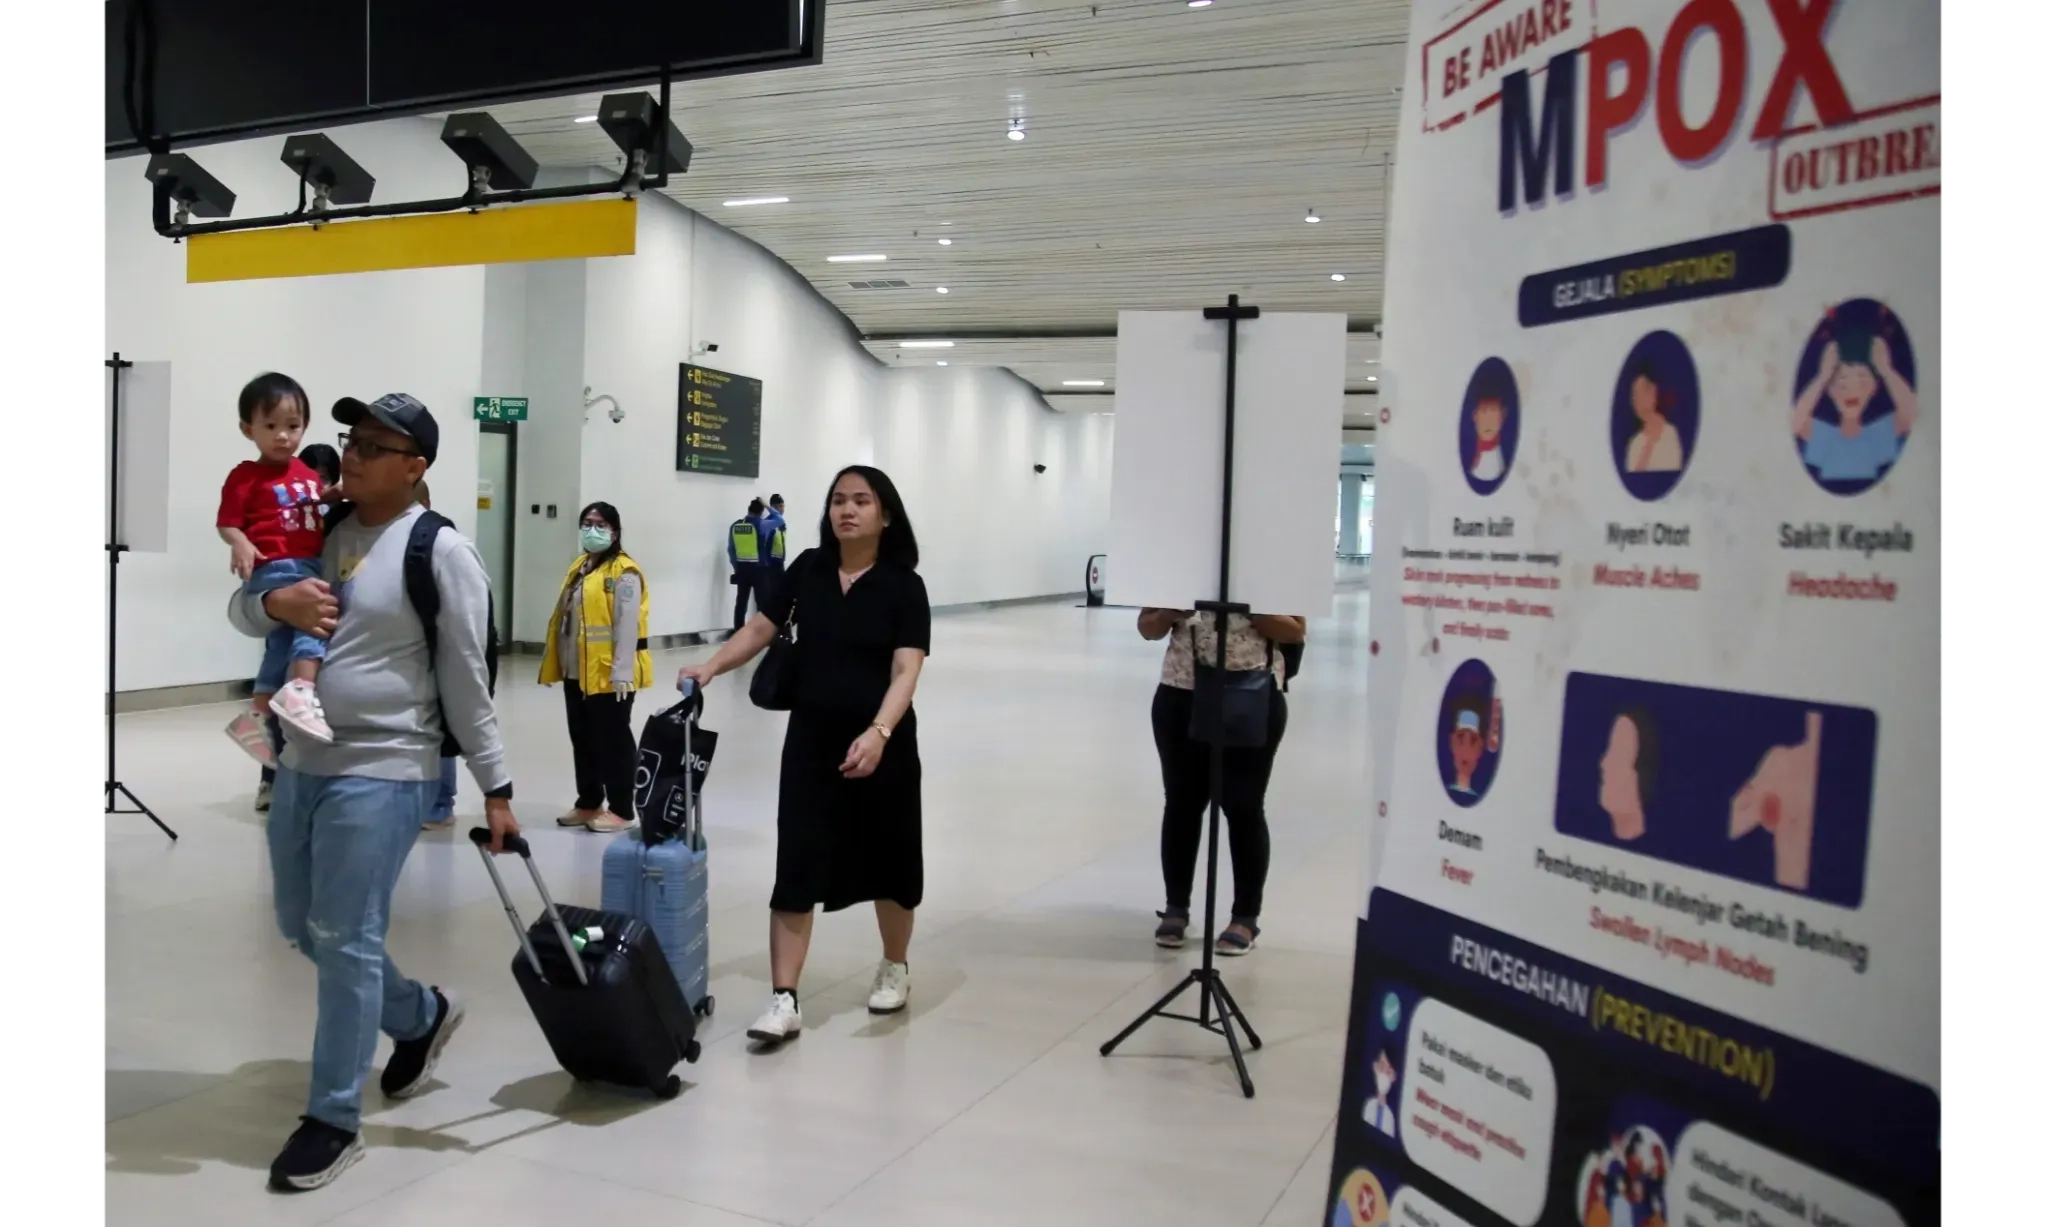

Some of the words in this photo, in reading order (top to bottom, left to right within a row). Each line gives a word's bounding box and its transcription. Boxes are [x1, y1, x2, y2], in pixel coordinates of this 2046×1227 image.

[1443, 48, 1471, 97] BE
[1478, 0, 1572, 79] AWARE
[1499, 0, 1857, 212] MPOX
[1552, 274, 1616, 309] GEJALA
[1619, 250, 1736, 299] (SYMPTOMS)
[1607, 522, 1649, 551] Nyeri
[1653, 523, 1691, 546] Otot
[1779, 522, 1831, 551] Sakit
[1837, 521, 1914, 559] Kepala
[1594, 563, 1646, 588] Muscle
[1651, 567, 1699, 591] Aches
[1788, 570, 1897, 601] Headache
[1438, 819, 1482, 850] Demam
[1441, 857, 1474, 885] Fever
[1535, 848, 1648, 893] Pembengkakan
[1652, 880, 1724, 925] Kelenjar
[1729, 902, 1789, 942] Getah
[1793, 919, 1869, 975] Bening
[1590, 905, 1650, 945] Swollen
[1654, 926, 1709, 966] Lymph
[1714, 945, 1774, 987] Nodes
[1452, 935, 1589, 1017] PENCEGAHAN
[1591, 985, 1775, 1100] (PREVENTION)
